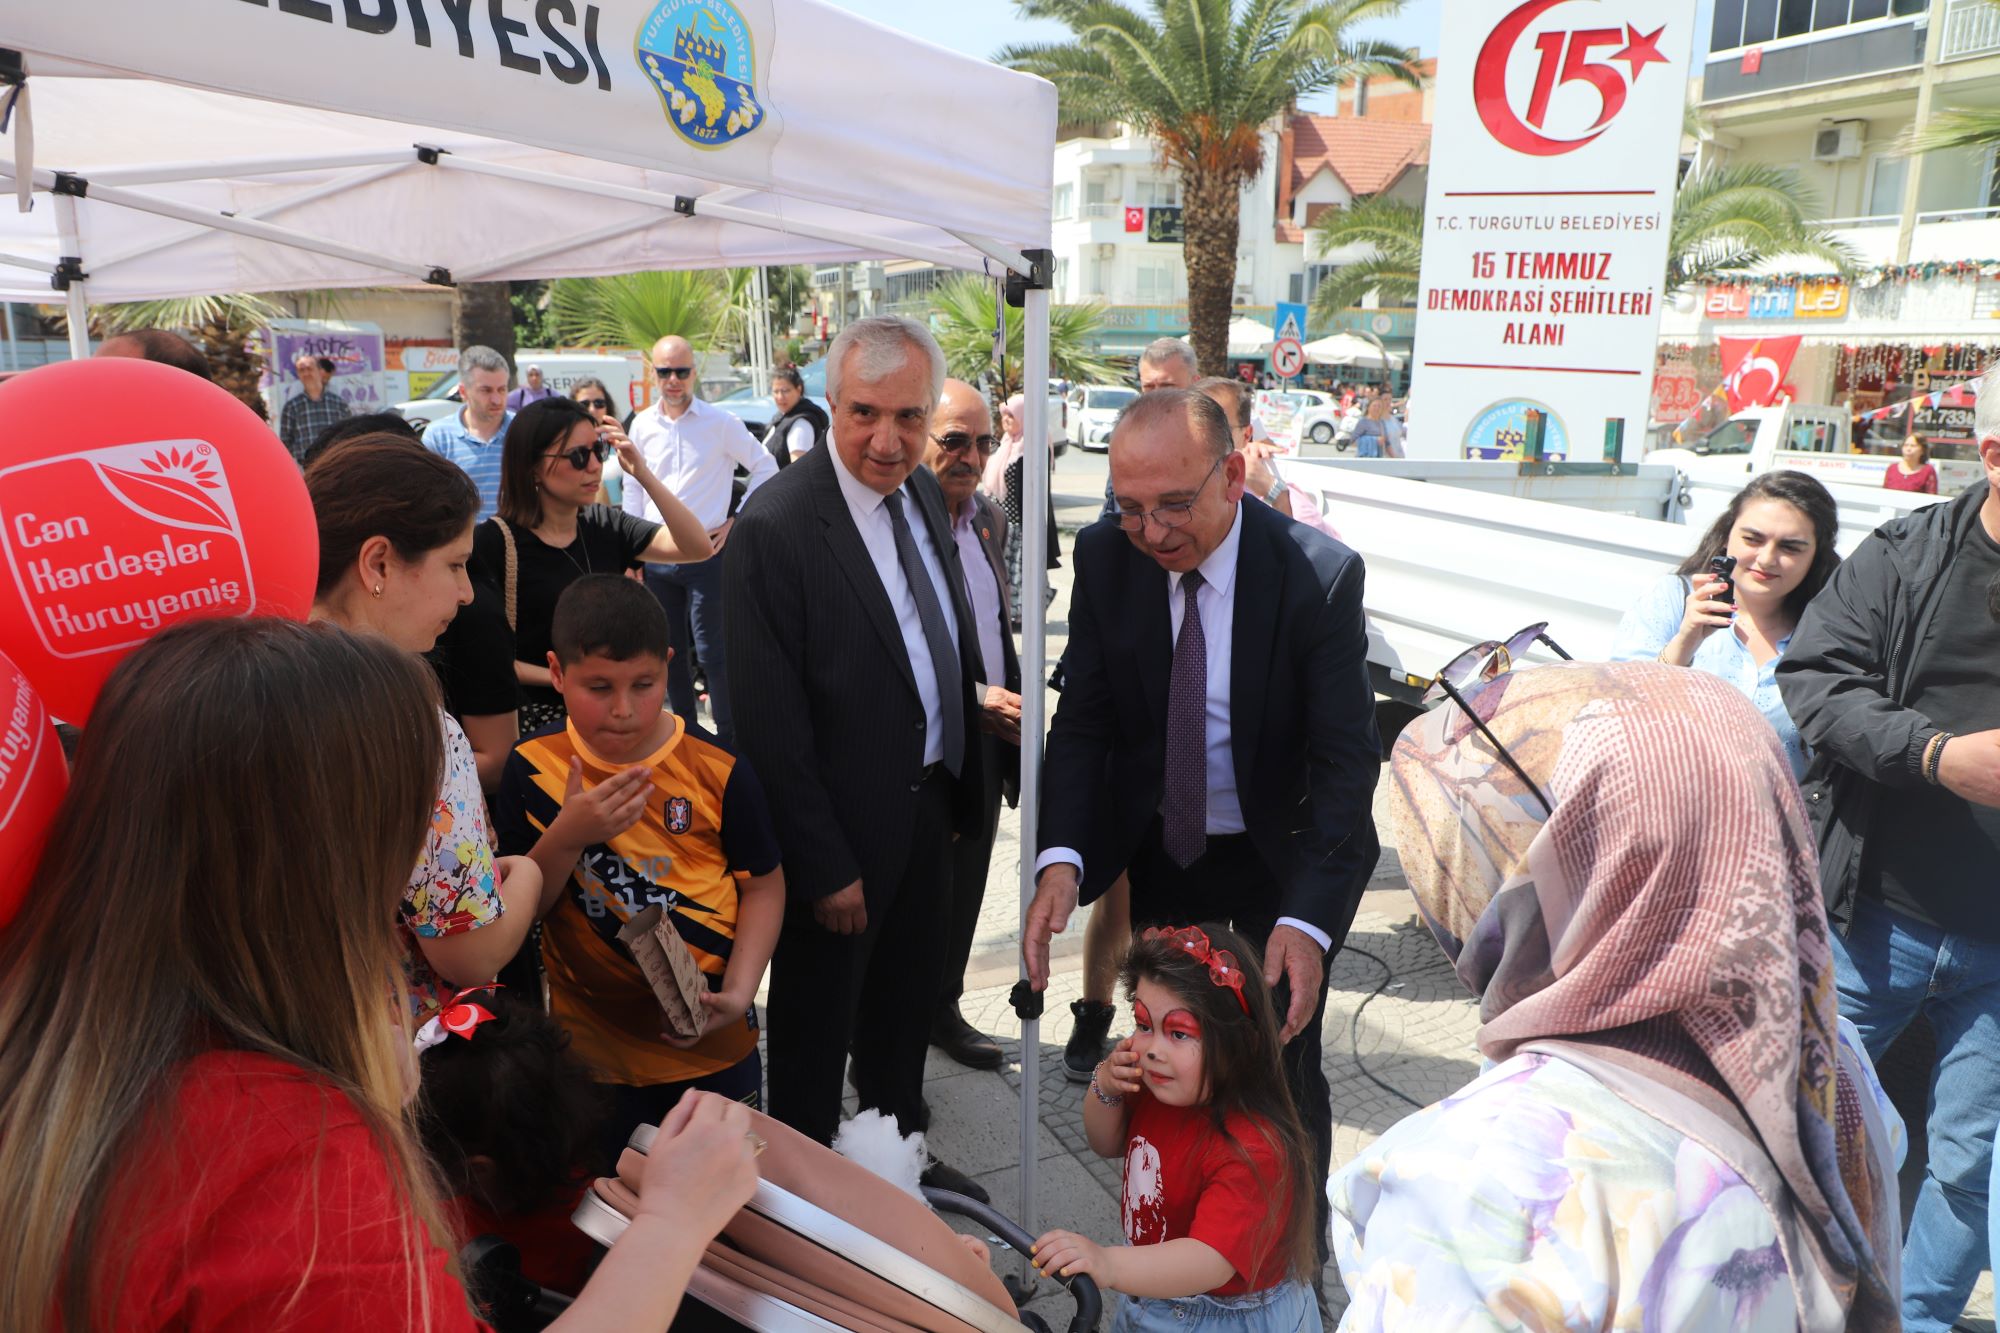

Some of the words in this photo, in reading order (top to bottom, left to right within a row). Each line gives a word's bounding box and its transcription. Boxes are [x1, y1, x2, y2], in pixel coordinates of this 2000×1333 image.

[643, 0, 704, 48] TURGU
[1526, 28, 1626, 131] 15
[694, 125, 719, 139] 1872
[1436, 216, 1463, 230] T.C.
[1469, 216, 1555, 230] TURGUTLU
[1560, 212, 1661, 230] BELEDİYESİ
[1472, 252, 1496, 279] 15
[1505, 252, 1612, 280] TEMMUZ
[1428, 285, 1545, 313] DEMOKRASİ
[1550, 285, 1653, 317] ŞEHİTLERİ
[1503, 323, 1565, 346] ALANI
[543, 376, 582, 390] SERV
[14, 512, 90, 548] Can
[27, 533, 212, 594] Kardeşler
[44, 577, 241, 638] Kuruyemiş
